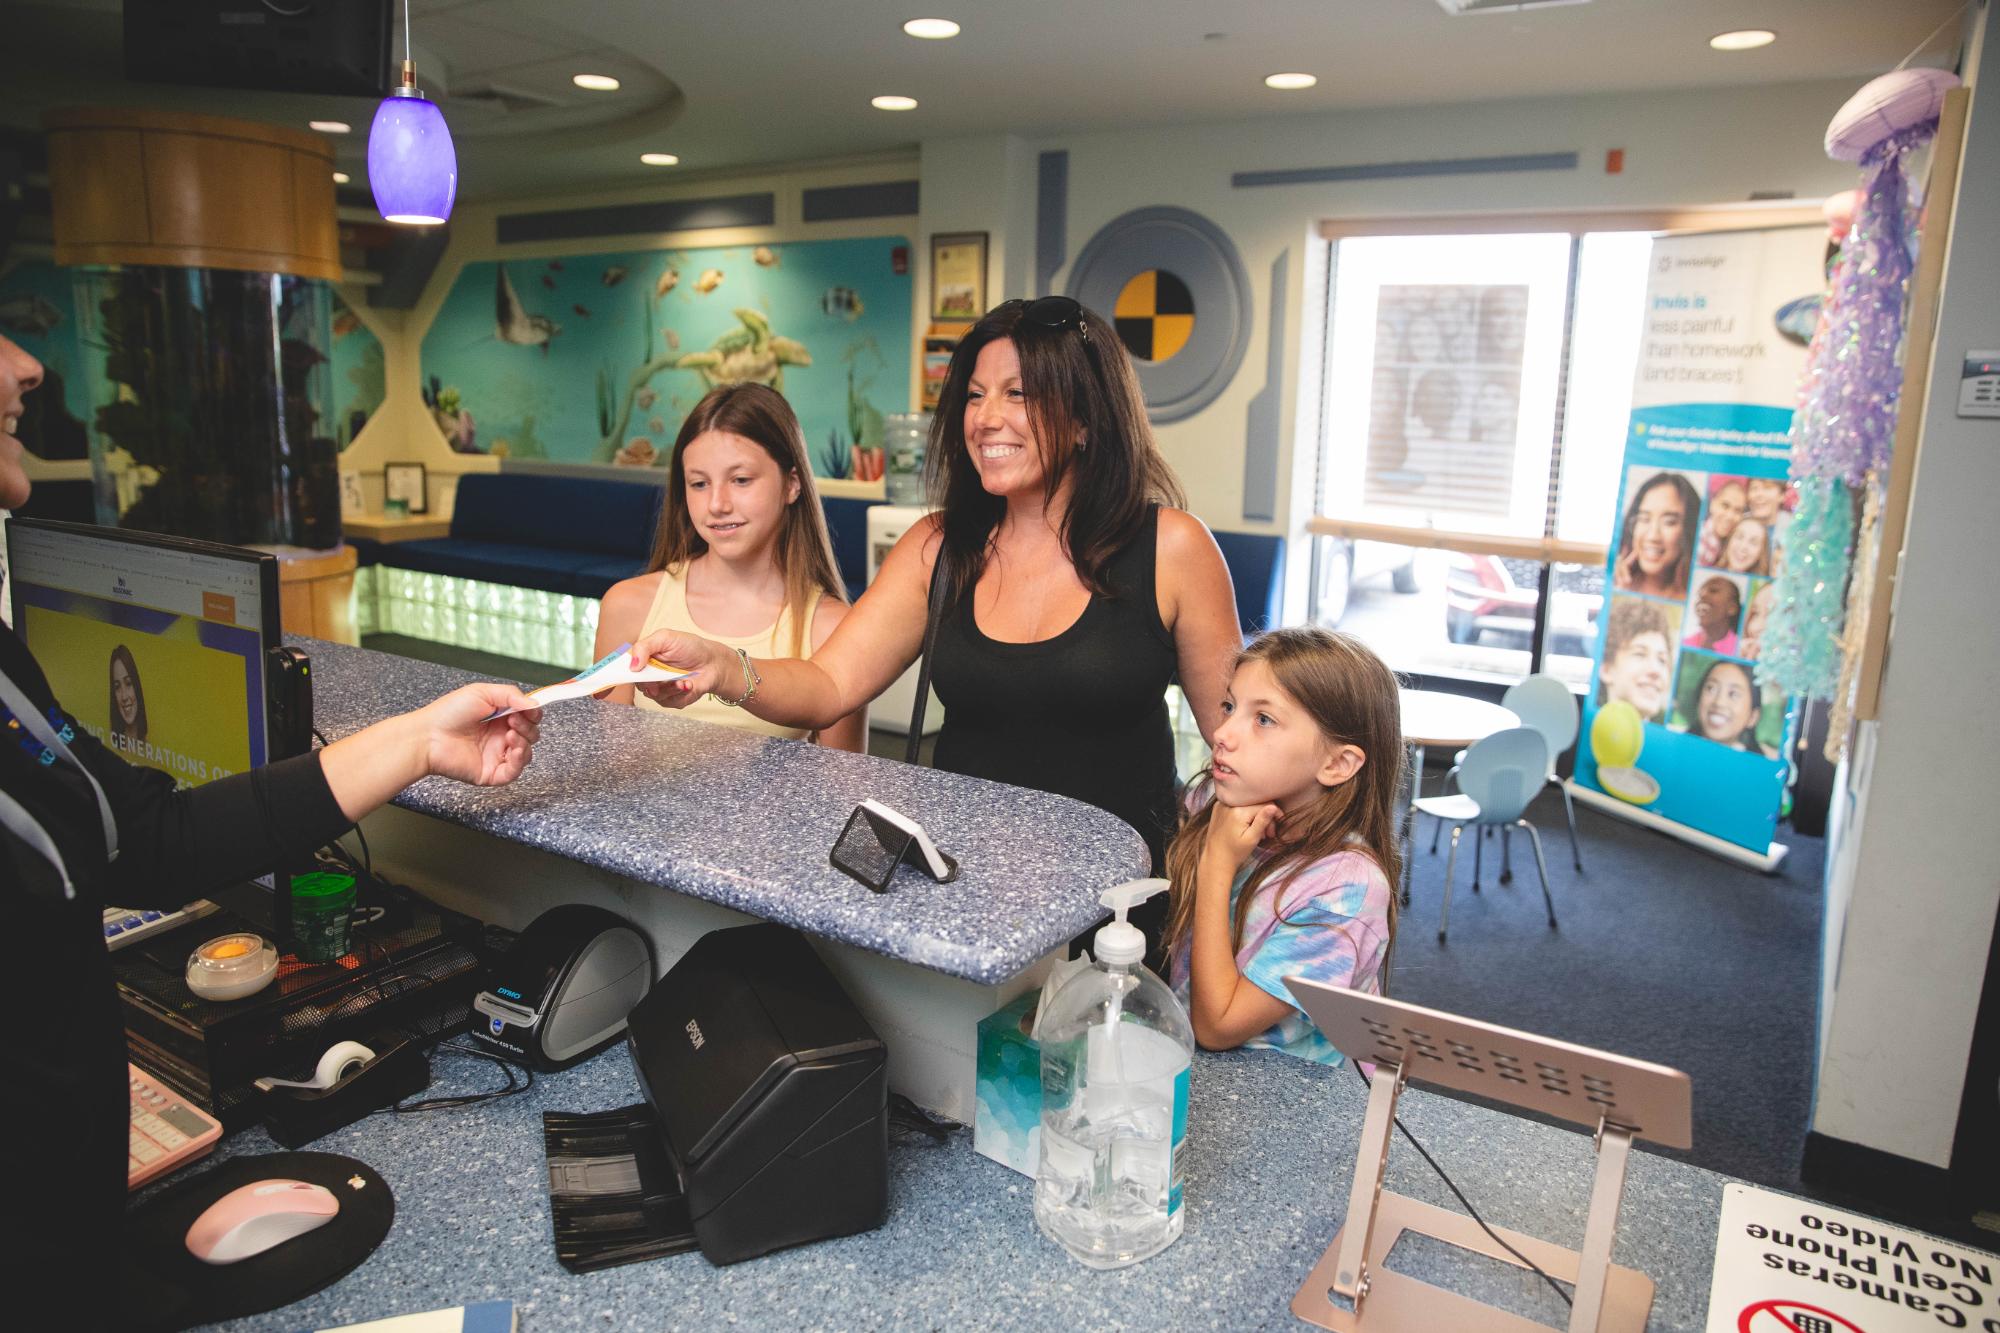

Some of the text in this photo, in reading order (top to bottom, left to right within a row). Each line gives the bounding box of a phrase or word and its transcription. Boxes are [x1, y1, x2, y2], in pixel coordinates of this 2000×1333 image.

[1650, 316, 1736, 335] less painful
[1647, 340, 1766, 359] than homework
[110, 731, 207, 779] GENERATIONS
[497, 987, 521, 999] DYMO
[685, 1018, 706, 1050] EPSON
[1745, 1223, 1878, 1276] Phone
[1800, 1214, 1920, 1263] Video
[1893, 1263, 1983, 1306] Cell
[1931, 1251, 1993, 1285] No
[1763, 1252, 1967, 1328] Cameras
